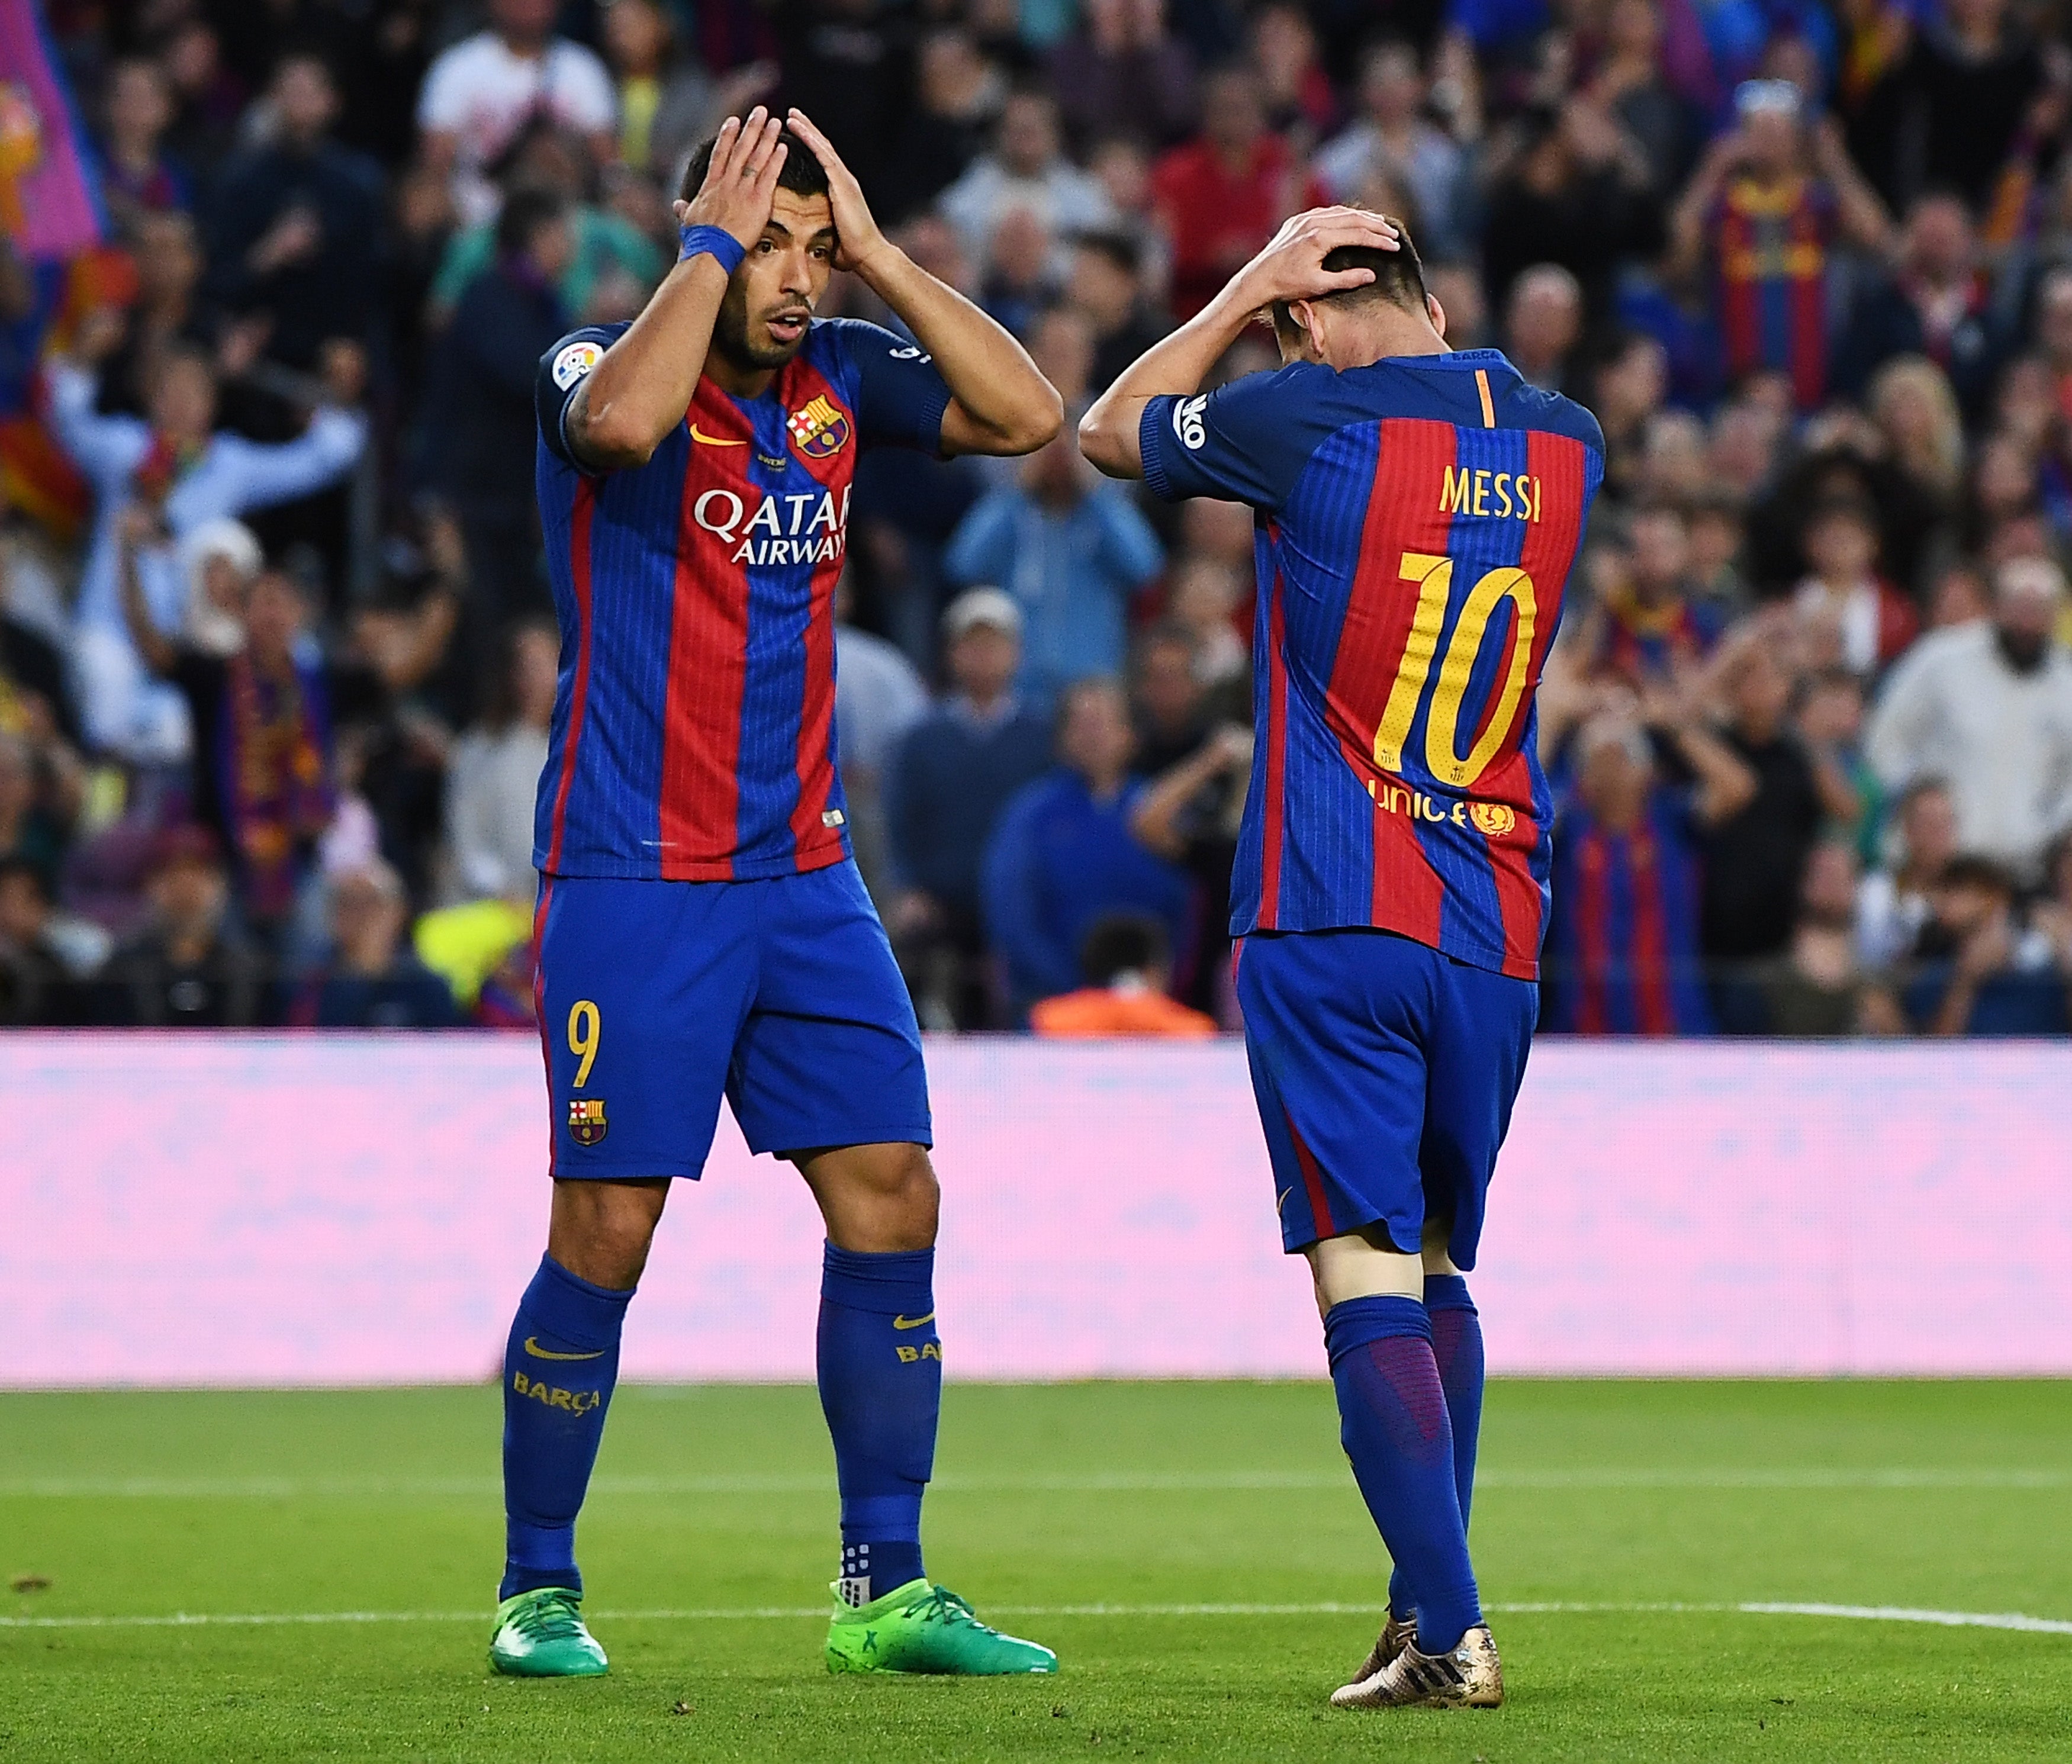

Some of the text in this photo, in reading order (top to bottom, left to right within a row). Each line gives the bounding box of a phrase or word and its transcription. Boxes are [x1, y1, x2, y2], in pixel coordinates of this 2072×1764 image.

[1439, 465, 1540, 523] MESSI
[1373, 552, 1537, 787] 10
[568, 1000, 600, 1088] 9
